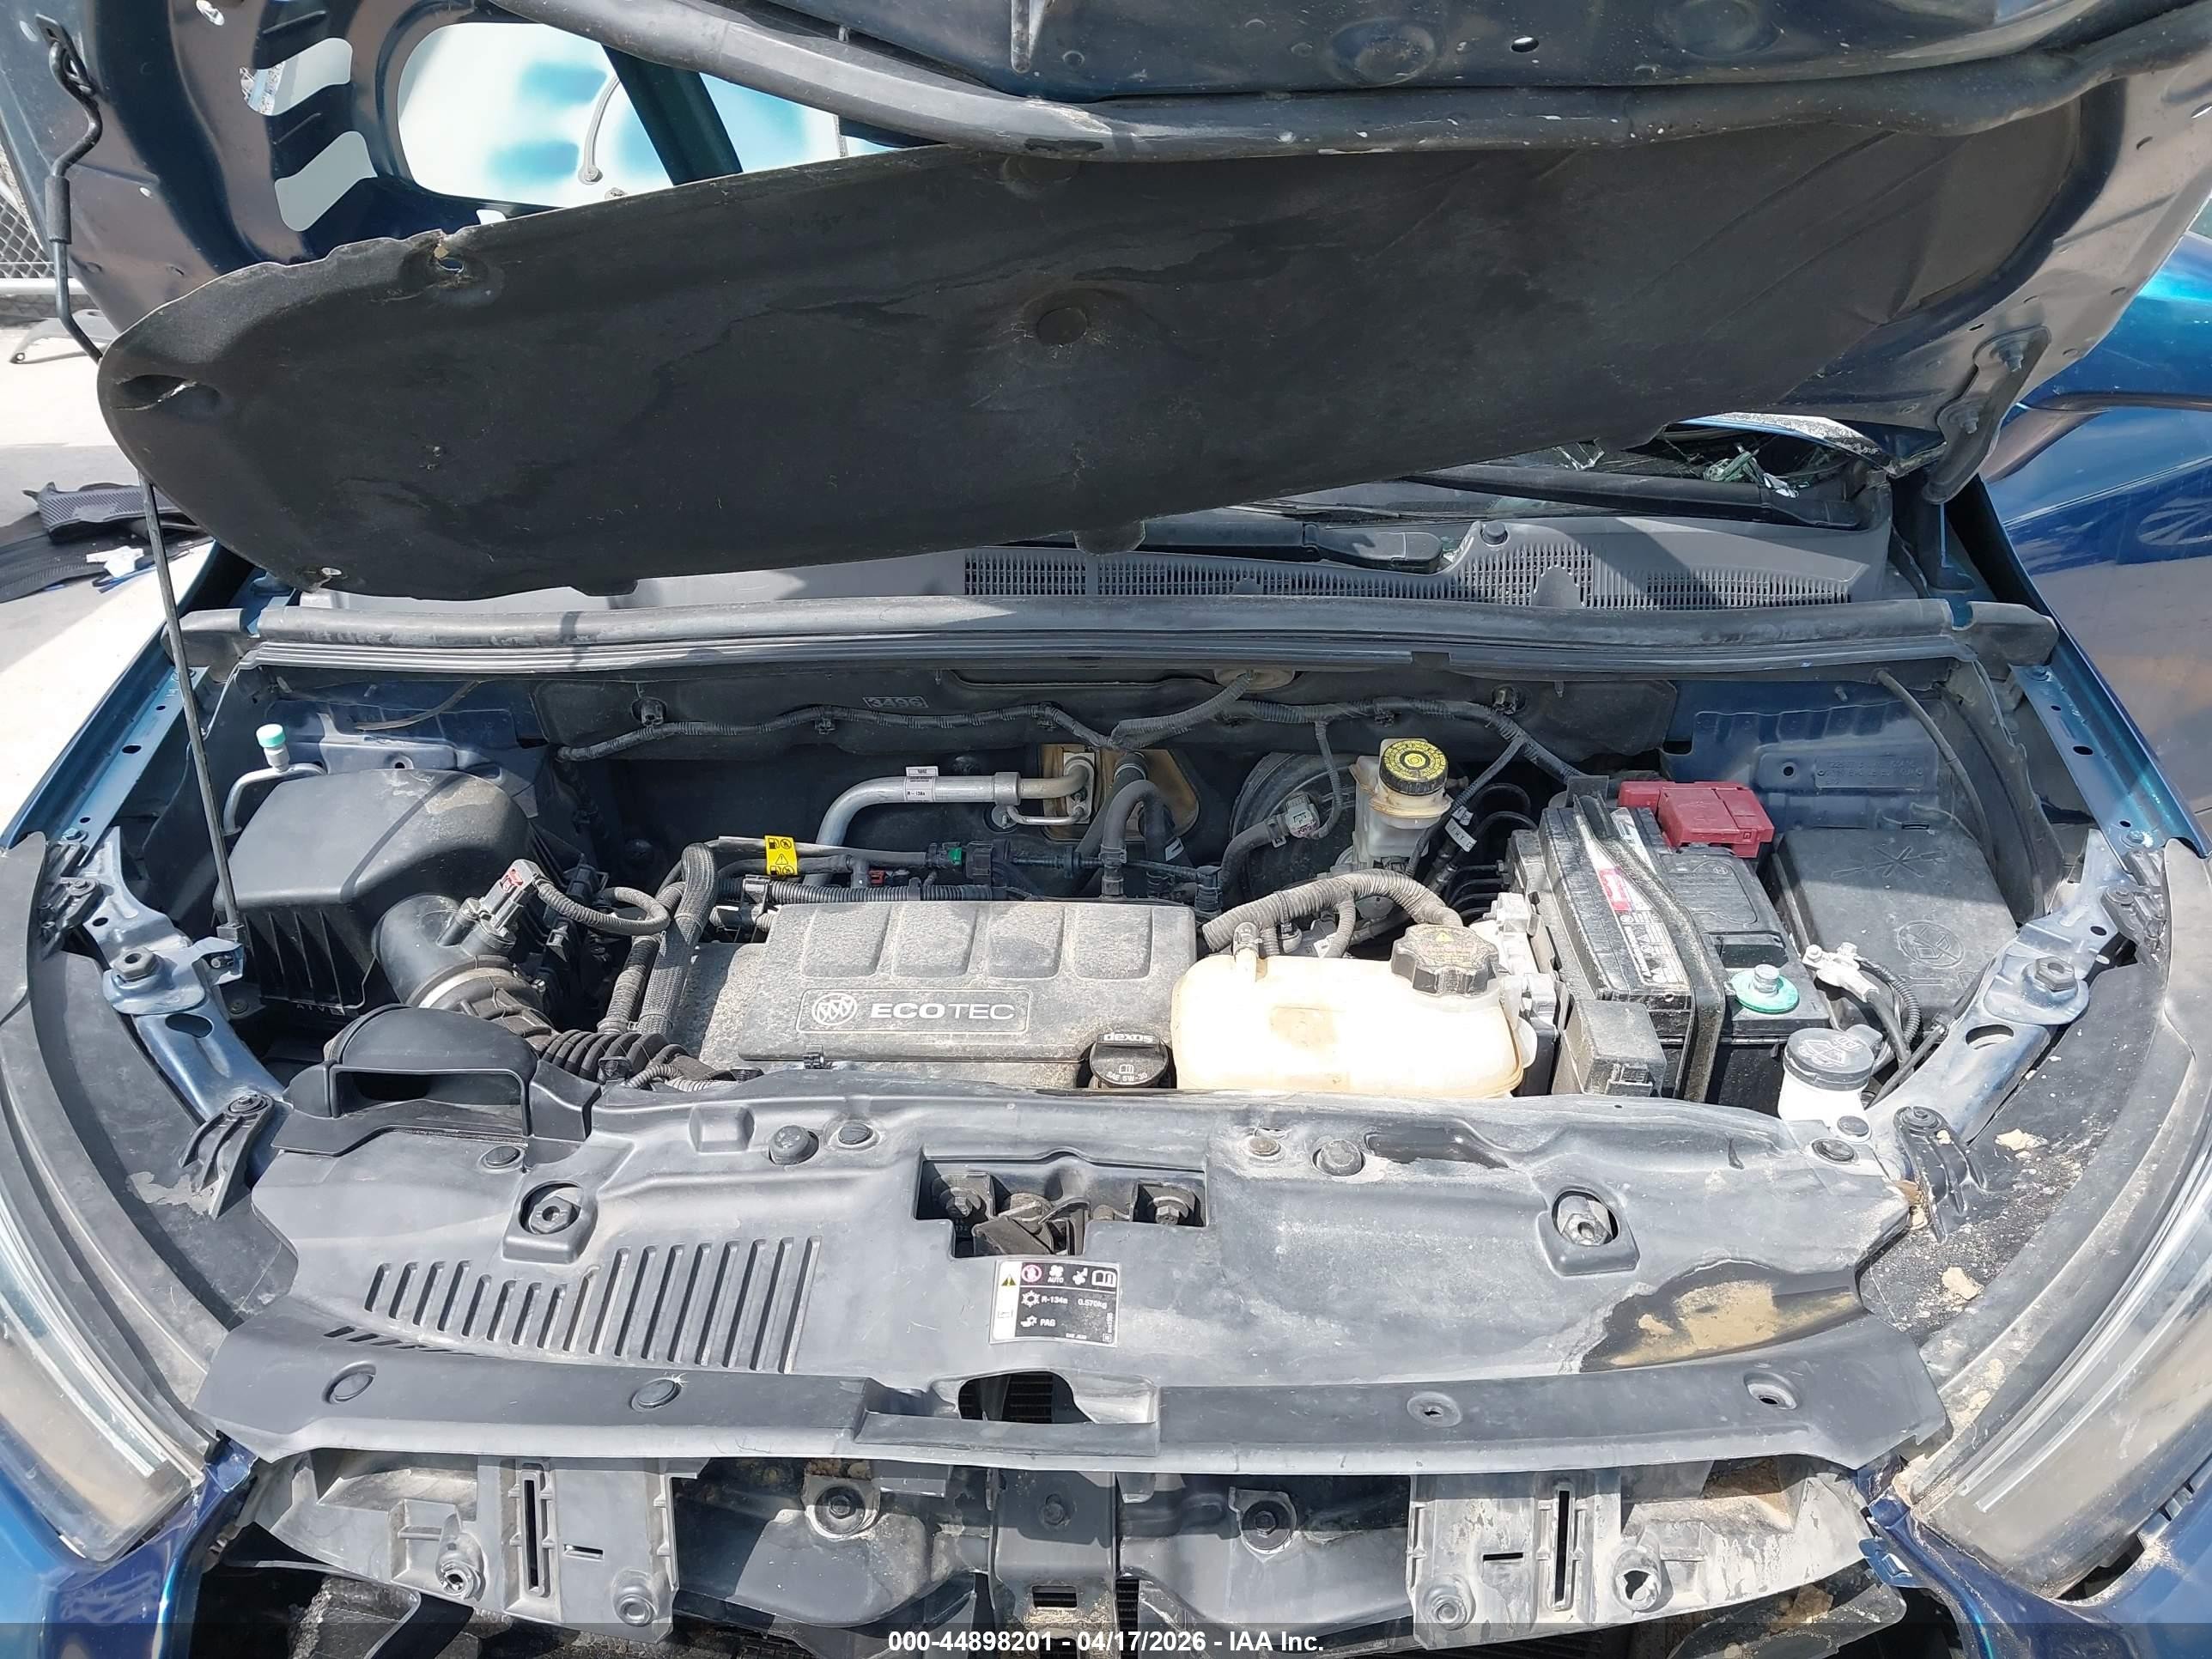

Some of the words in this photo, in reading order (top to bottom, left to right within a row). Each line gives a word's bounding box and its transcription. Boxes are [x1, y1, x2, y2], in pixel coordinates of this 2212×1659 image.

[870, 1001, 1015, 1020] ECOTEC
[1103, 1032, 1156, 1042] dexos
[1106, 1071, 1121, 1081] SAE
[1121, 1072, 1148, 1082] 5W-30
[1039, 1318, 1056, 1327] PAG
